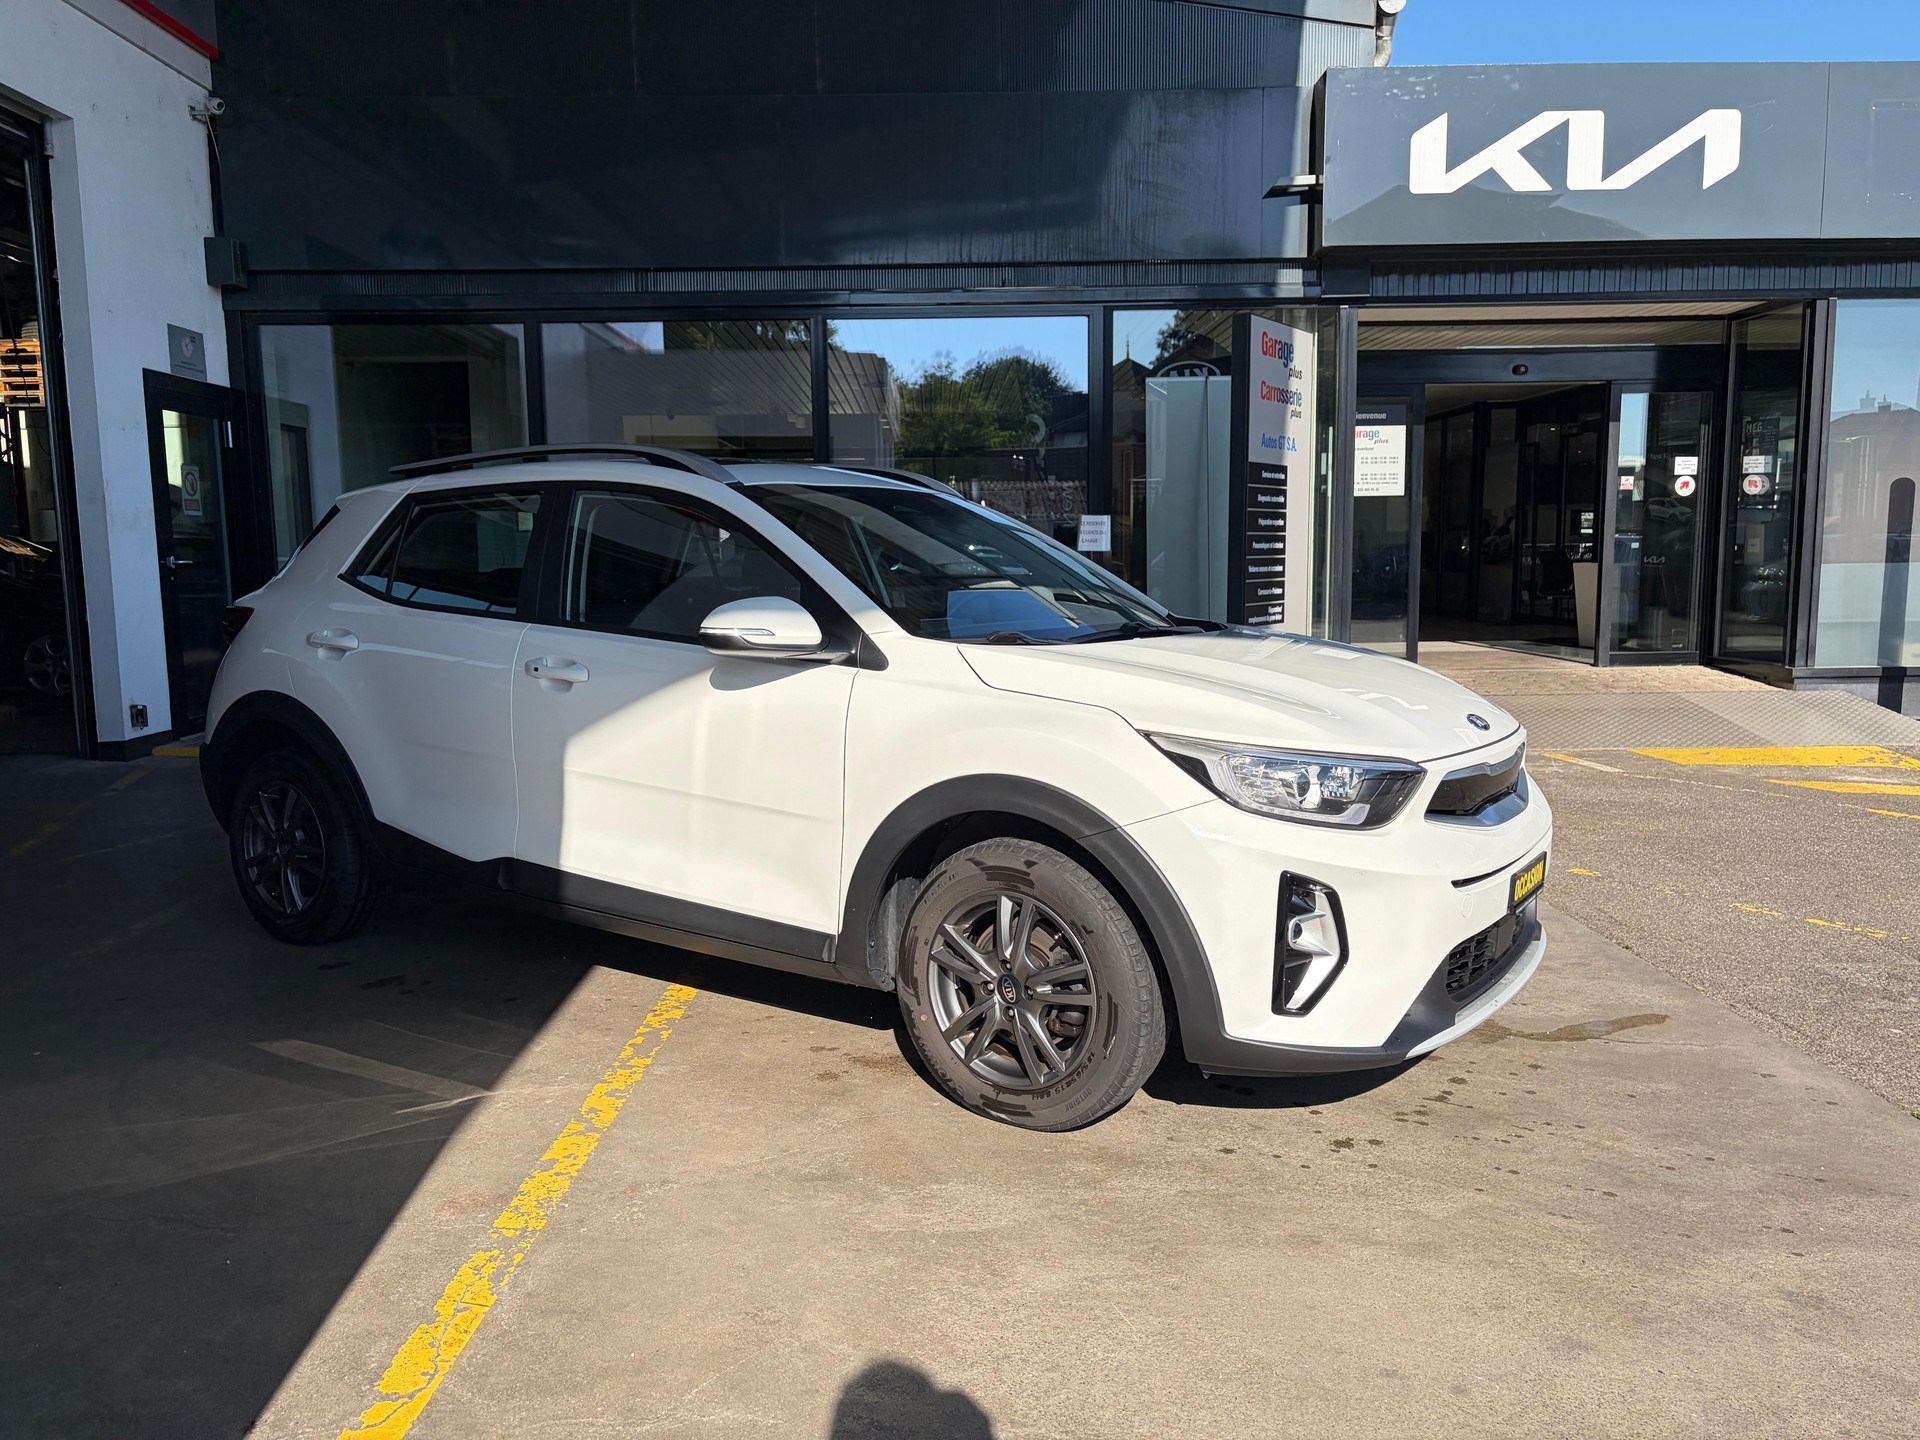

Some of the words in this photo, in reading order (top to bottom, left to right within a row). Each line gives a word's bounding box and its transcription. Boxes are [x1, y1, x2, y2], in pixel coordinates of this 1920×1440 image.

[1409, 109, 1742, 194] KIA
[1261, 331, 1294, 368] Garage
[1288, 365, 1302, 380] plus
[1261, 380, 1302, 407] Carrosserie
[1290, 408, 1302, 419] plus
[1355, 411, 1387, 420] ienvenue
[1261, 433, 1277, 449] Autos
[1278, 435, 1286, 450] GT
[1514, 860, 1544, 901] OCCASION
[1004, 981, 1014, 998] KIA
[1053, 1048, 1096, 1096] 185/65R15
[1064, 1087, 1093, 1112] OUTSIDE
